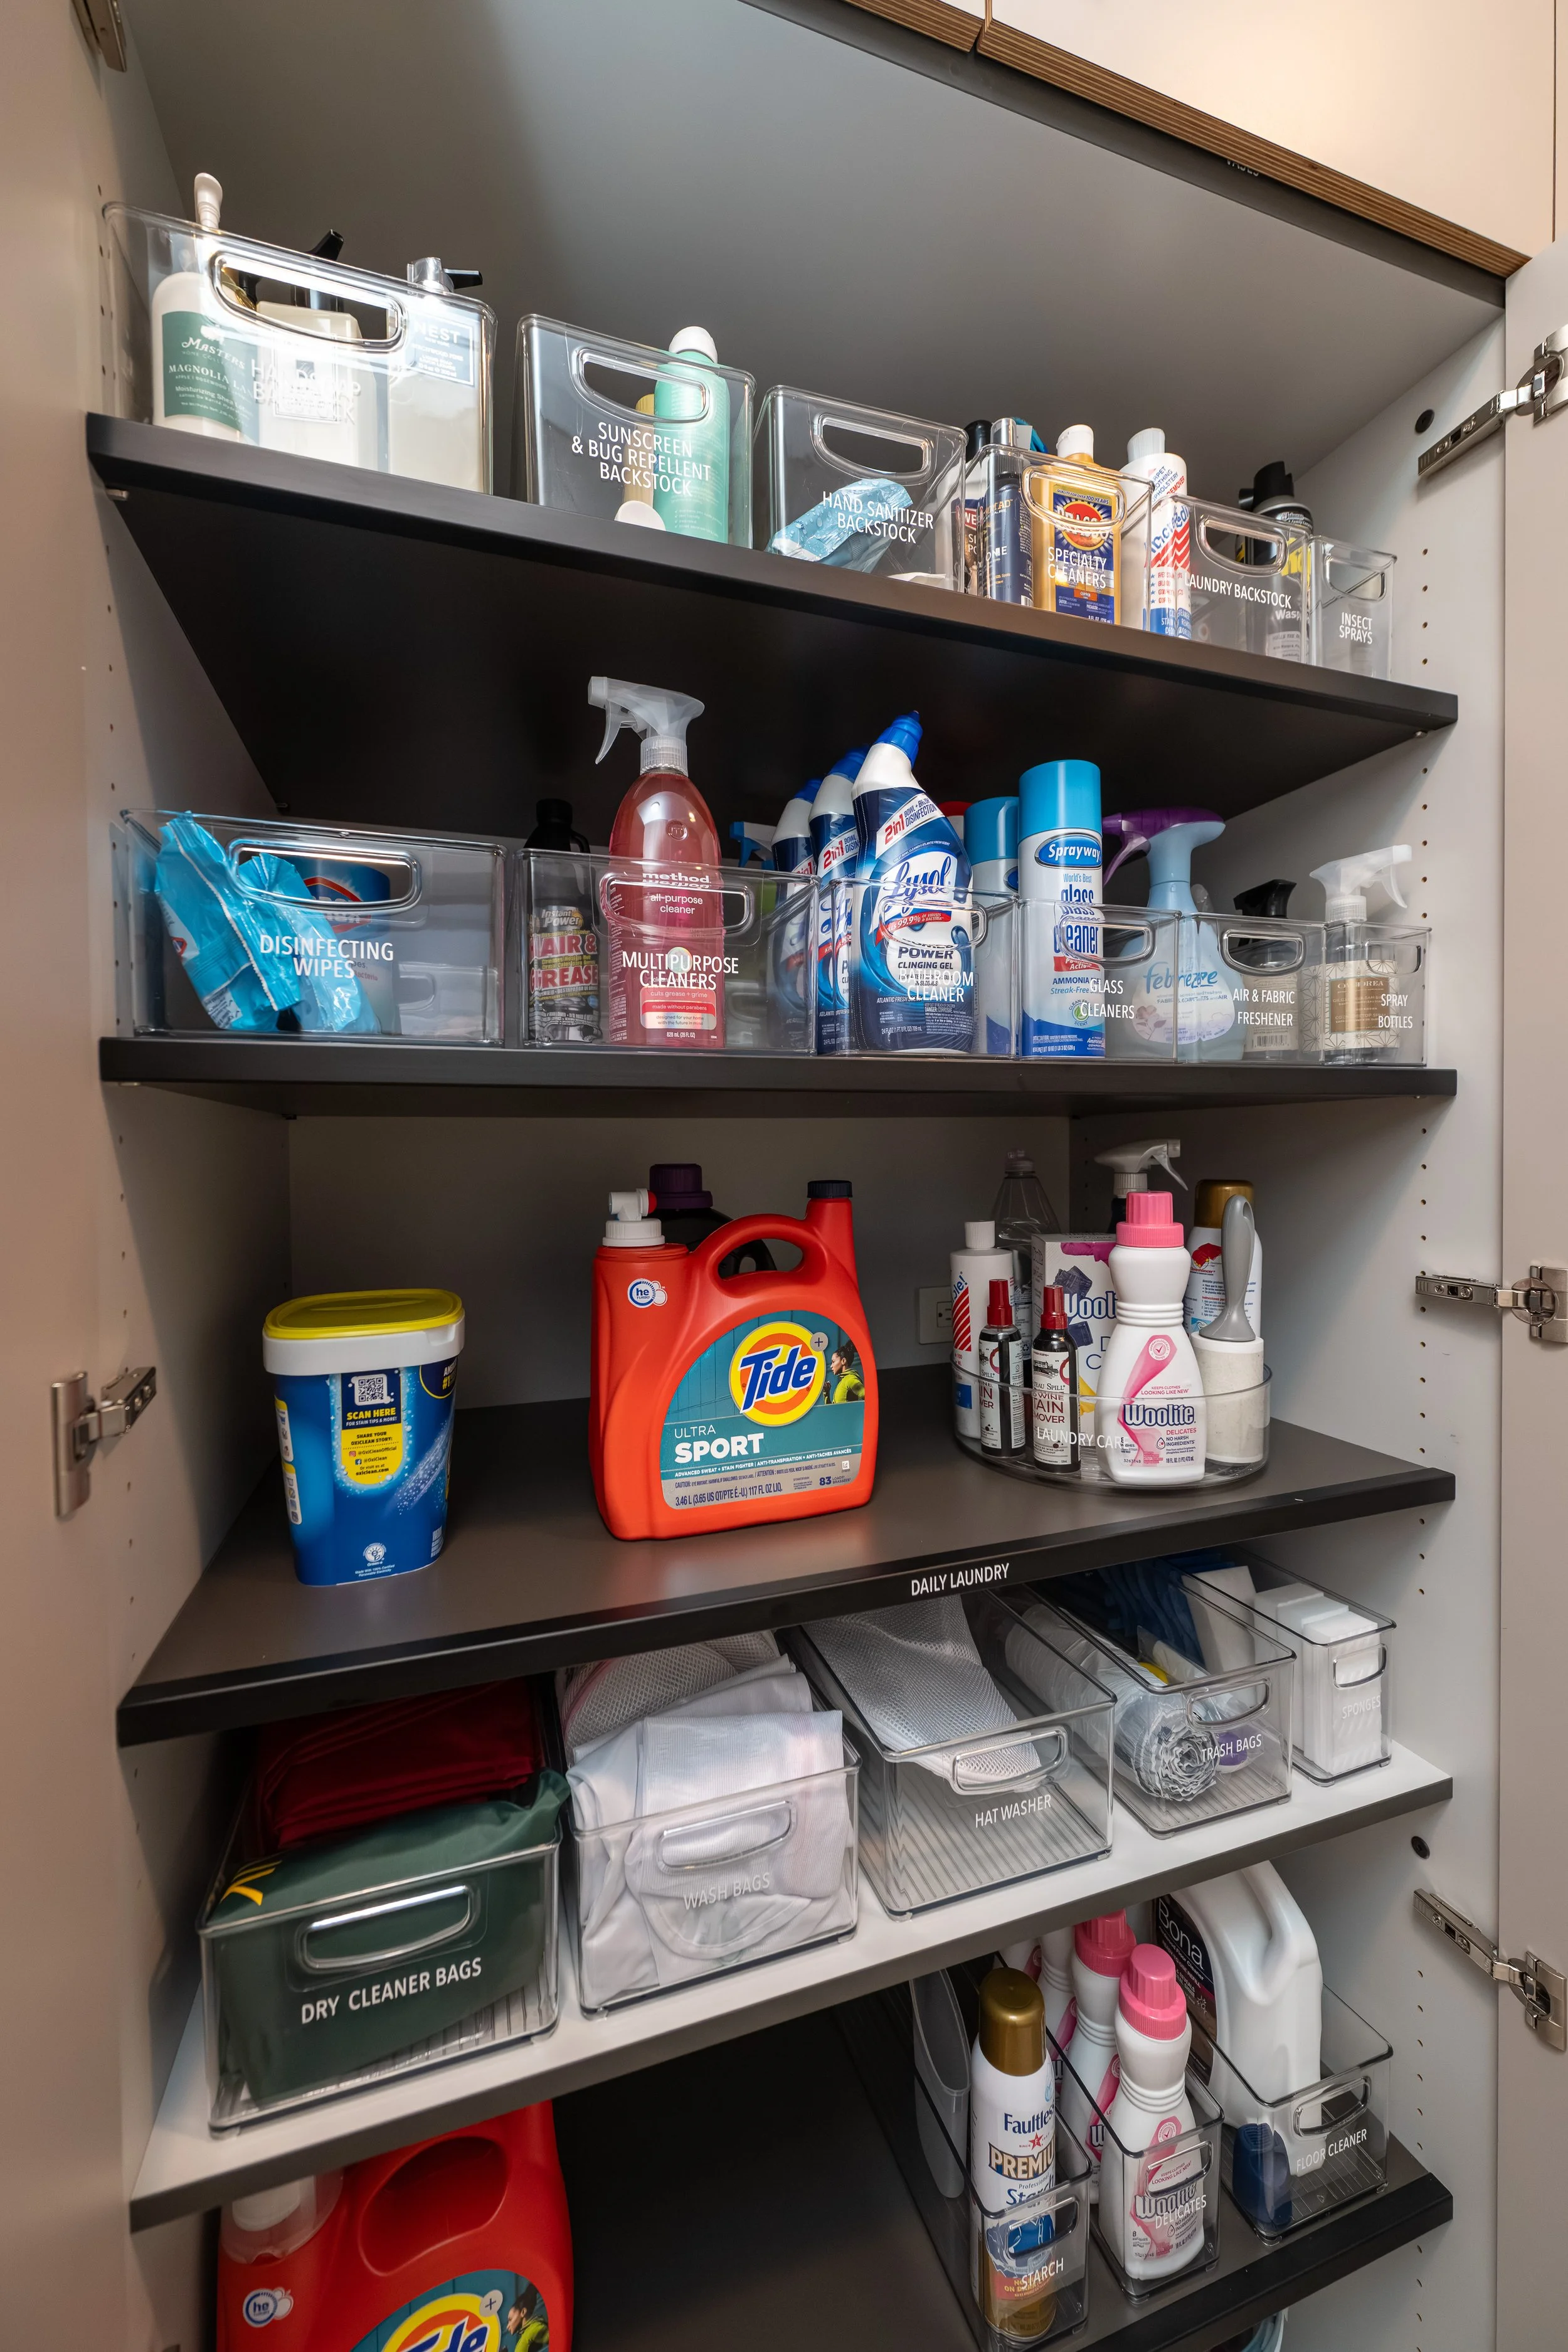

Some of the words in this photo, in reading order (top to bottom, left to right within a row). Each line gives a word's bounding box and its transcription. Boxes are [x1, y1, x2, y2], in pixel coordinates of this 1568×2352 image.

[169, 364, 230, 384] MAGNOLIA
[175, 386, 215, 398] Moisturizing
[217, 393, 233, 405] Shea
[598, 421, 692, 457] SUNSCREEN
[571, 435, 583, 455] &
[588, 438, 623, 463] BUG
[628, 446, 711, 482] REPELLENT
[599, 460, 692, 497] BACKSTOCK
[822, 491, 863, 514] HAND
[867, 500, 934, 531] SANITIZER
[837, 511, 916, 544] BACKSTOCK
[1047, 546, 1107, 572] SPECIALTY
[1047, 563, 1106, 589] CLEANERS
[1184, 572, 1232, 600] LAUNDRY
[1234, 580, 1291, 608] BACKSTOCK
[1341, 612, 1372, 632] INSECT
[1338, 625, 1373, 645] SPRAYS
[885, 813, 905, 845] 2in1
[904, 805, 916, 817] BOWL
[906, 803, 938, 827] DISINFECTION
[823, 840, 844, 870] 2in1
[844, 834, 857, 845] BOWL
[1048, 844, 1101, 862] Sprayway
[884, 855, 952, 909] Lysol
[1063, 872, 1081, 882] World's
[1083, 873, 1092, 883] Best
[650, 893, 703, 904] all-purpose
[660, 904, 696, 914] cleaner
[541, 909, 573, 918] Instant
[543, 916, 580, 928] Power
[898, 915, 921, 927] 99.9%
[260, 934, 394, 961] DISINFECTING
[585, 933, 598, 955] &
[1054, 923, 1098, 953] ceaner
[622, 951, 739, 974] MULTIPURPOSE
[898, 946, 954, 959] POWER
[293, 957, 356, 980] WIPES
[898, 961, 938, 970] CLINGING
[640, 970, 717, 990] CLEANERS
[900, 968, 974, 987] BATHROOM
[1089, 978, 1124, 994] GLASS
[1143, 961, 1218, 993] febreze
[908, 985, 965, 1002] CLEANER
[1051, 986, 1089, 995] Streak-Free
[1232, 988, 1249, 1002] AIR
[1252, 989, 1259, 1003] &
[1261, 989, 1295, 1004] FABRIC
[1380, 993, 1408, 1007] SPRAY
[1069, 999, 1081, 1010] CLEAN
[1080, 1002, 1135, 1019] CLEANERS
[1237, 1011, 1293, 1027] FRESHENER
[1378, 1015, 1413, 1029] BOTTLES
[636, 1288, 650, 1296] he
[738, 1344, 817, 1414] Tide
[347, 1410, 371, 1421] SCAN
[373, 1407, 396, 1417] HERE
[1123, 1404, 1195, 1427] Woolite
[674, 1424, 716, 1439] ULTRA
[1037, 1426, 1094, 1447] LAUNDRY
[674, 1433, 765, 1464] SPORT
[756, 1456, 802, 1466] ANTI-TRANSPIRATION
[356, 1468, 389, 1476] oxiclean.com
[675, 1481, 691, 1489] CAUTION:
[757, 1469, 775, 1477] ATTENTION
[819, 1476, 832, 1486] 83
[675, 1496, 687, 1506] 3.46
[693, 1493, 706, 1506] (3.65
[707, 1491, 714, 1502] US
[715, 1489, 734, 1502] QT/PTE
[748, 1485, 758, 1496] 117
[758, 1485, 765, 1495] FL
[765, 1484, 772, 1493] OZ
[773, 1482, 783, 1493] LIQ.
[911, 1573, 948, 1597] DAILY
[950, 1563, 1010, 1590] LAUNDRY
[1341, 1695, 1382, 1720] SPONGES
[1200, 1744, 1233, 1762] TRASH
[1236, 1734, 1263, 1755] BAGS
[975, 1811, 1000, 1828] HAT
[1000, 1793, 1052, 1823] WASHER
[683, 1883, 729, 1910] WASH
[731, 1872, 771, 1899] BAGS
[1158, 1898, 1204, 1970] Bona
[1187, 1960, 1204, 1981] Cleaner
[301, 1994, 340, 2025] DRY
[347, 1971, 432, 2011] CLEANER
[435, 1956, 483, 1989] BAGS
[1004, 2104, 1054, 2134] Faultles
[989, 2136, 1055, 2179] PREMIU
[1296, 2148, 1327, 2174] FLOOR
[1328, 2129, 1368, 2159] CLEANER
[1152, 2175, 1173, 2185] LOOKING
[1173, 2170, 1182, 2178] LIKE
[1182, 2161, 1191, 2173] NEW
[1172, 2162, 1185, 2173] CLOTHES
[1019, 2174, 1050, 2189] Professional
[1155, 2195, 1207, 2229] DELICATES
[1021, 2257, 1064, 2290] STARCH
